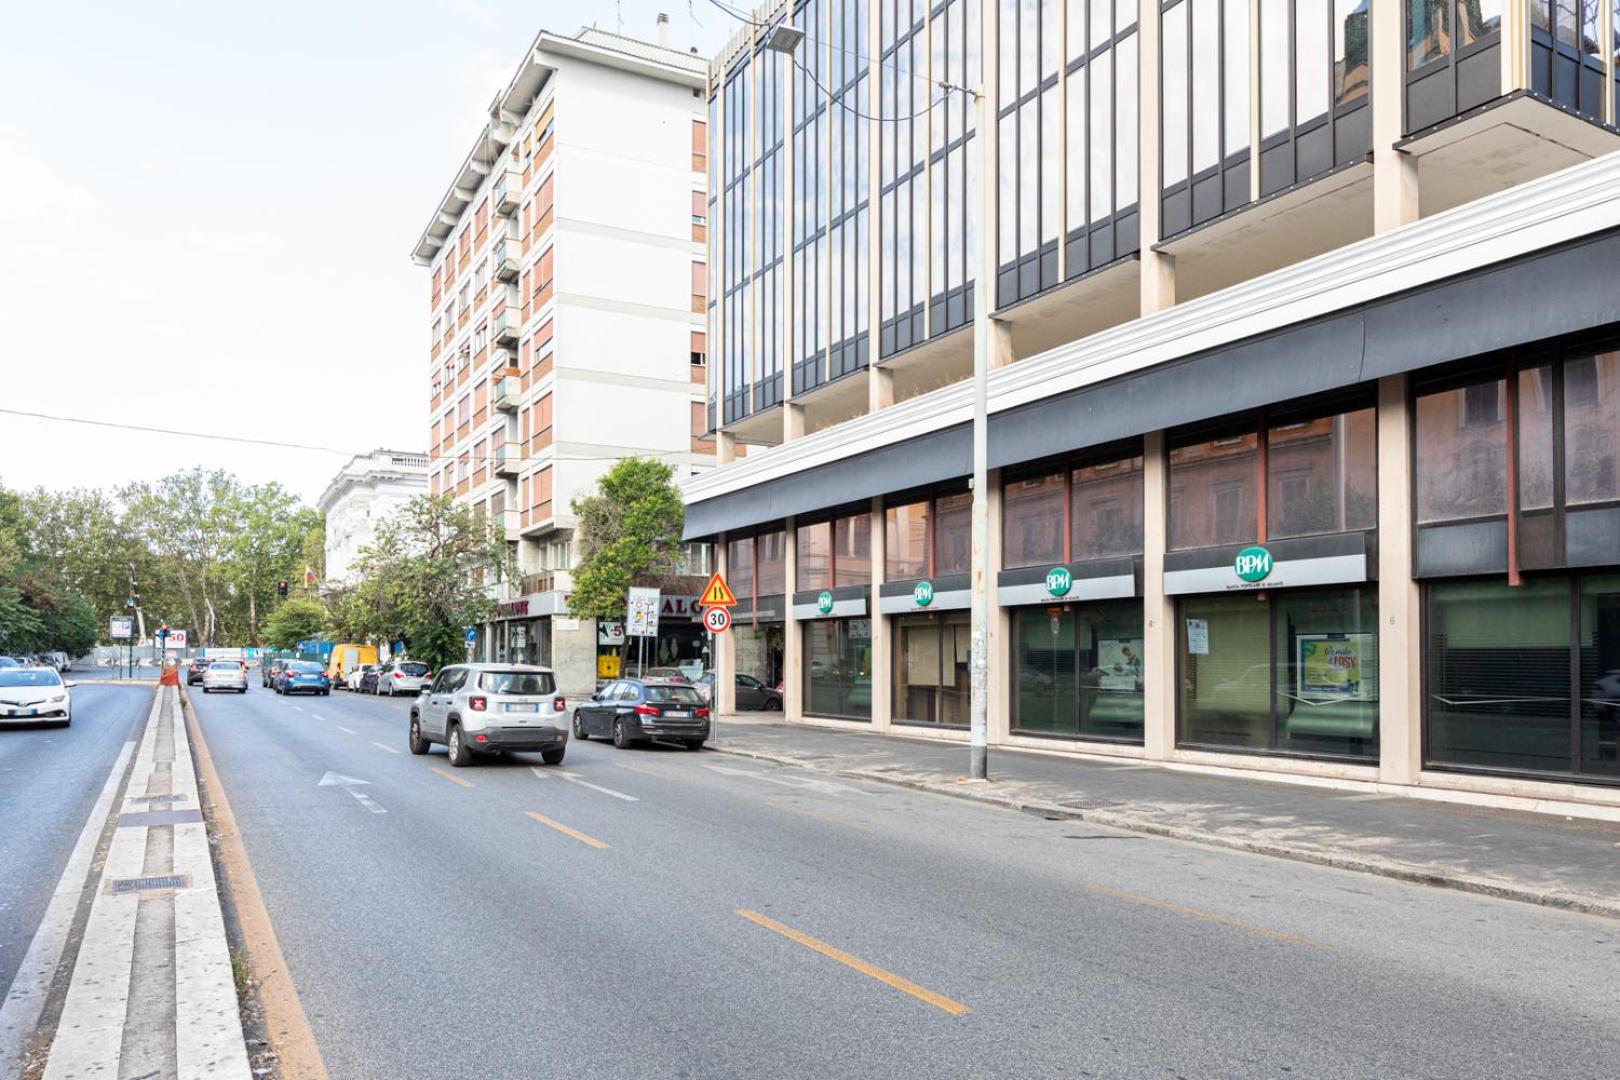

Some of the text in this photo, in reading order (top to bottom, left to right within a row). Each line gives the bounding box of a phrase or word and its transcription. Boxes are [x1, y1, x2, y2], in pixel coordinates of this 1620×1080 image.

[1235, 553, 1271, 575] BPM
[1046, 572, 1071, 590] BPM
[661, 598, 704, 614] ALO
[710, 613, 725, 626] 30
